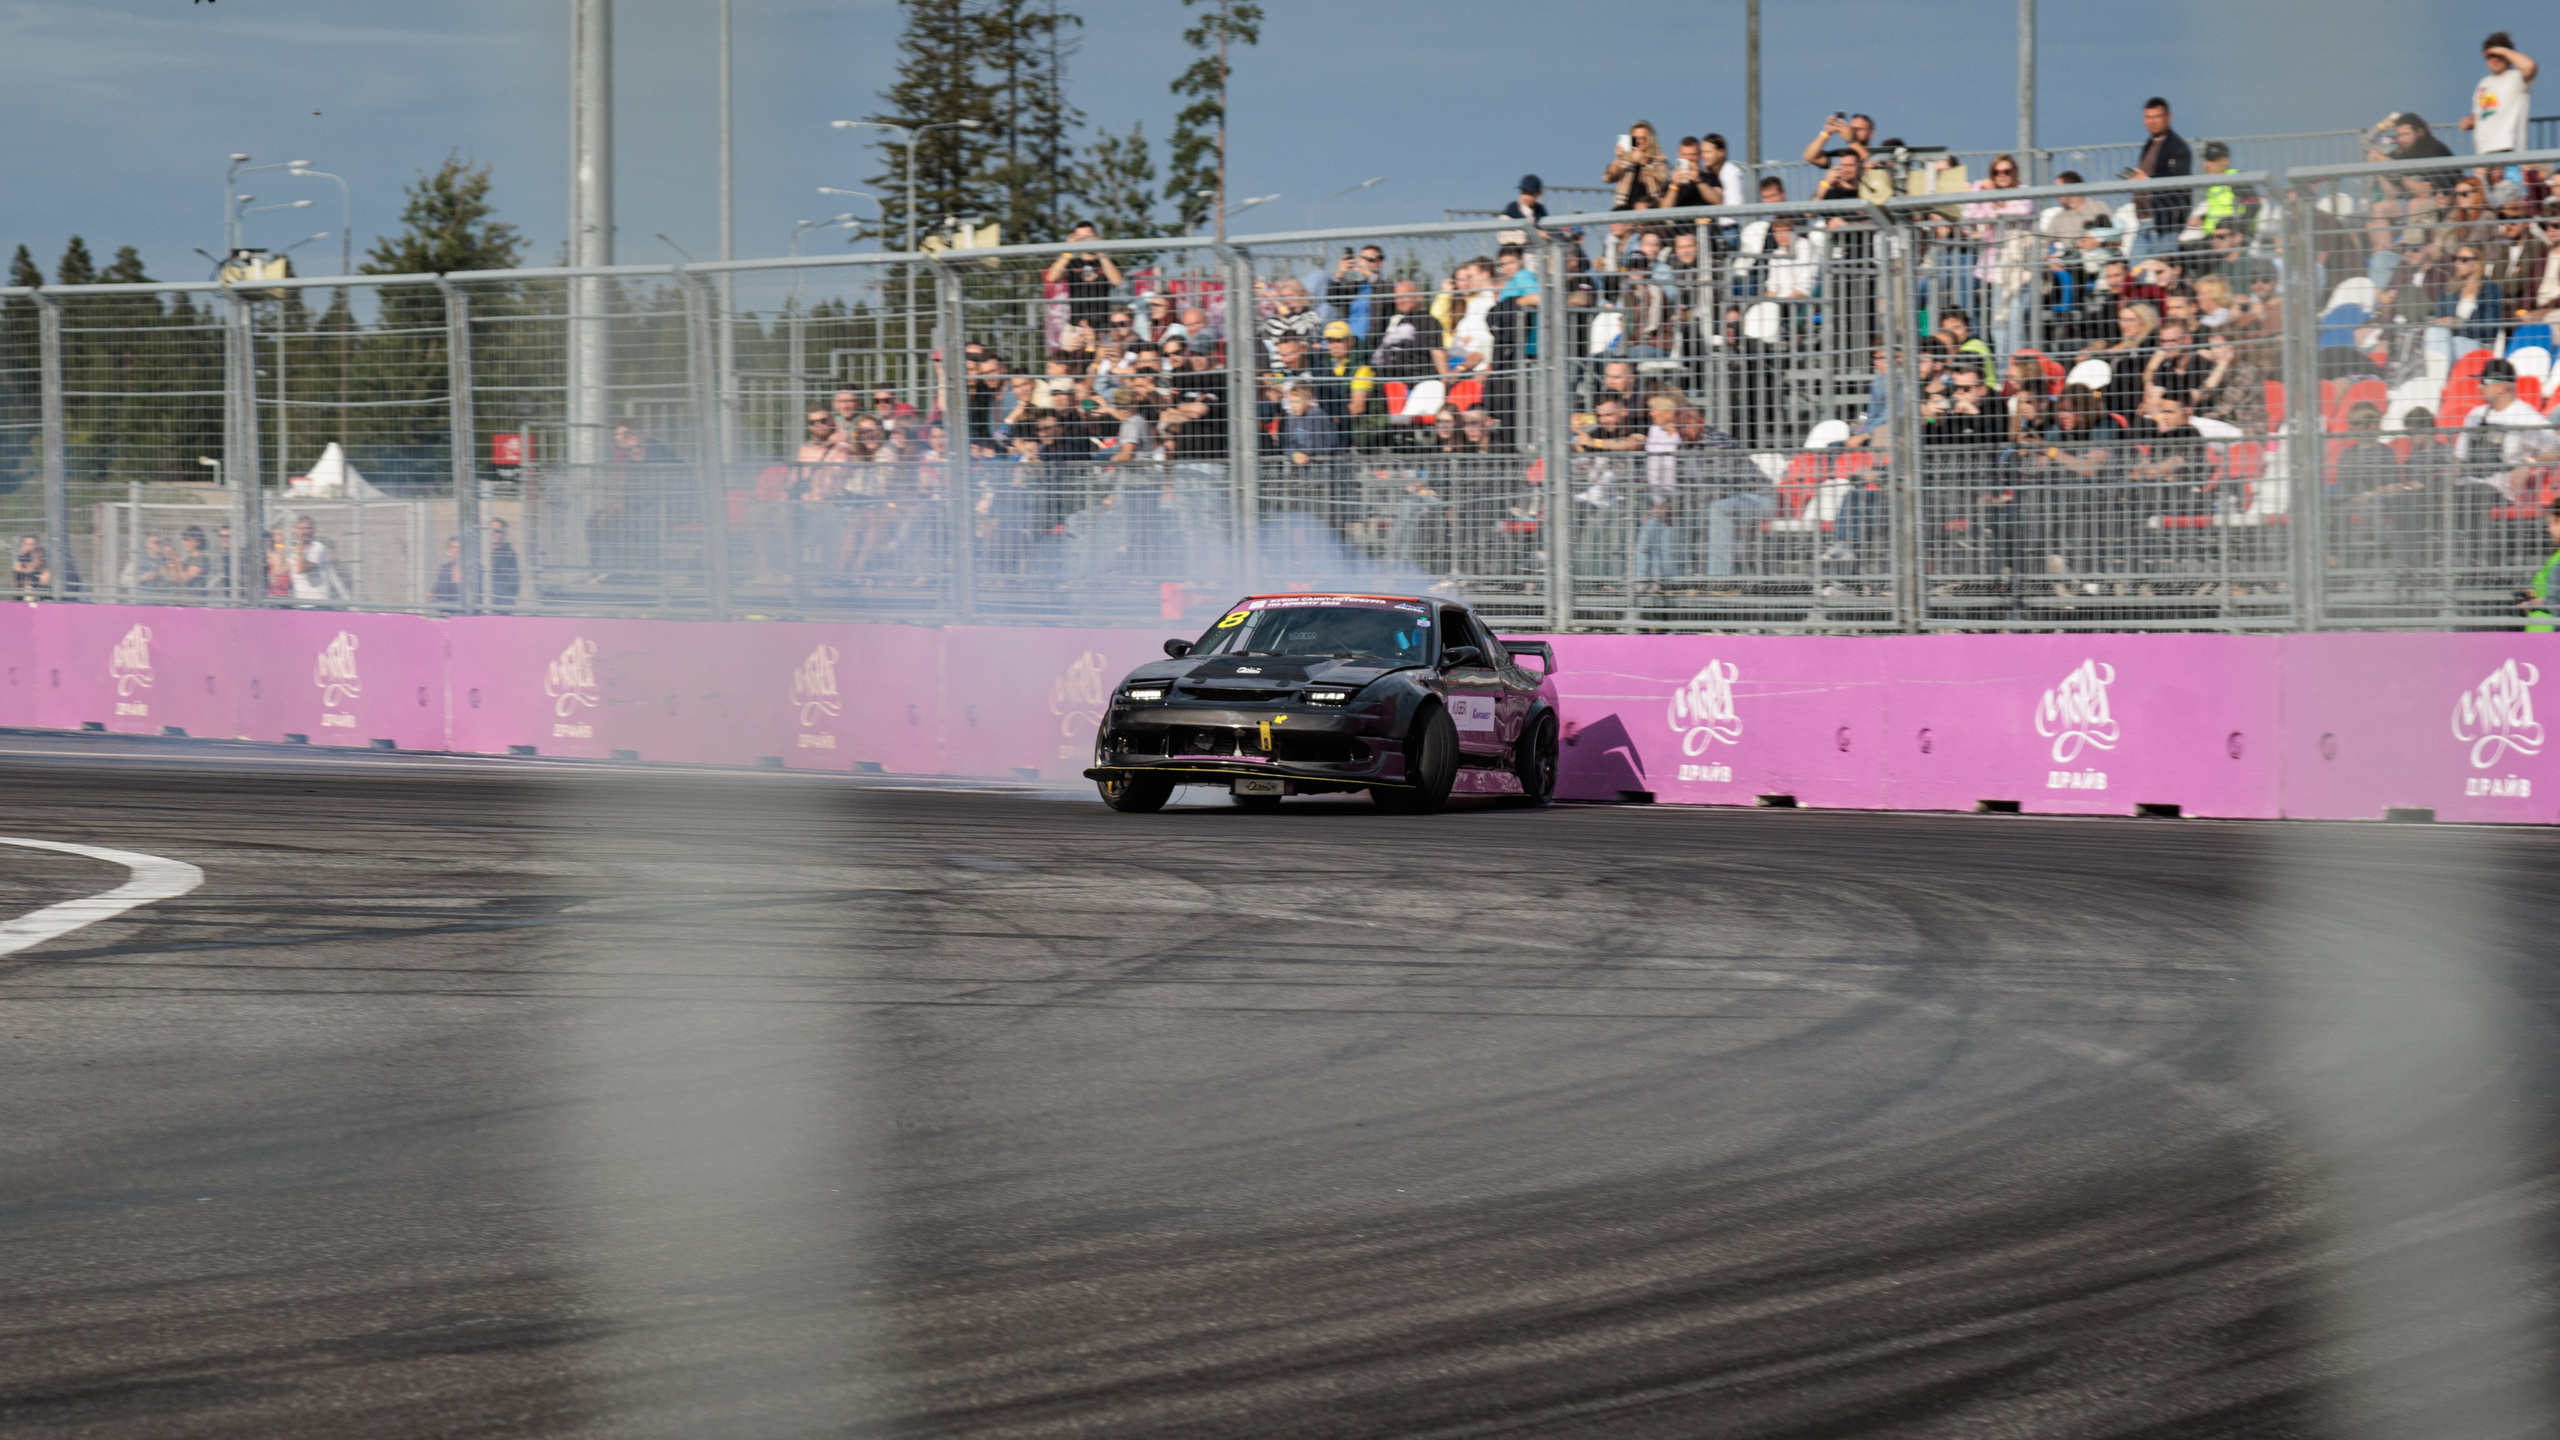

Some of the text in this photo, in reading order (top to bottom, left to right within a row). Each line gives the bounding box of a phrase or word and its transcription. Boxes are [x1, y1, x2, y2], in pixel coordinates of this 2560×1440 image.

[1301, 596, 1387, 605] САНКТ-ПЕТЕРБУРГА
[1217, 610, 1251, 629] 8
[1678, 761, 1733, 783] ДРАЙВ
[2047, 767, 2107, 790] ДРАЙВ
[2465, 774, 2533, 798] ДРАЙВ
